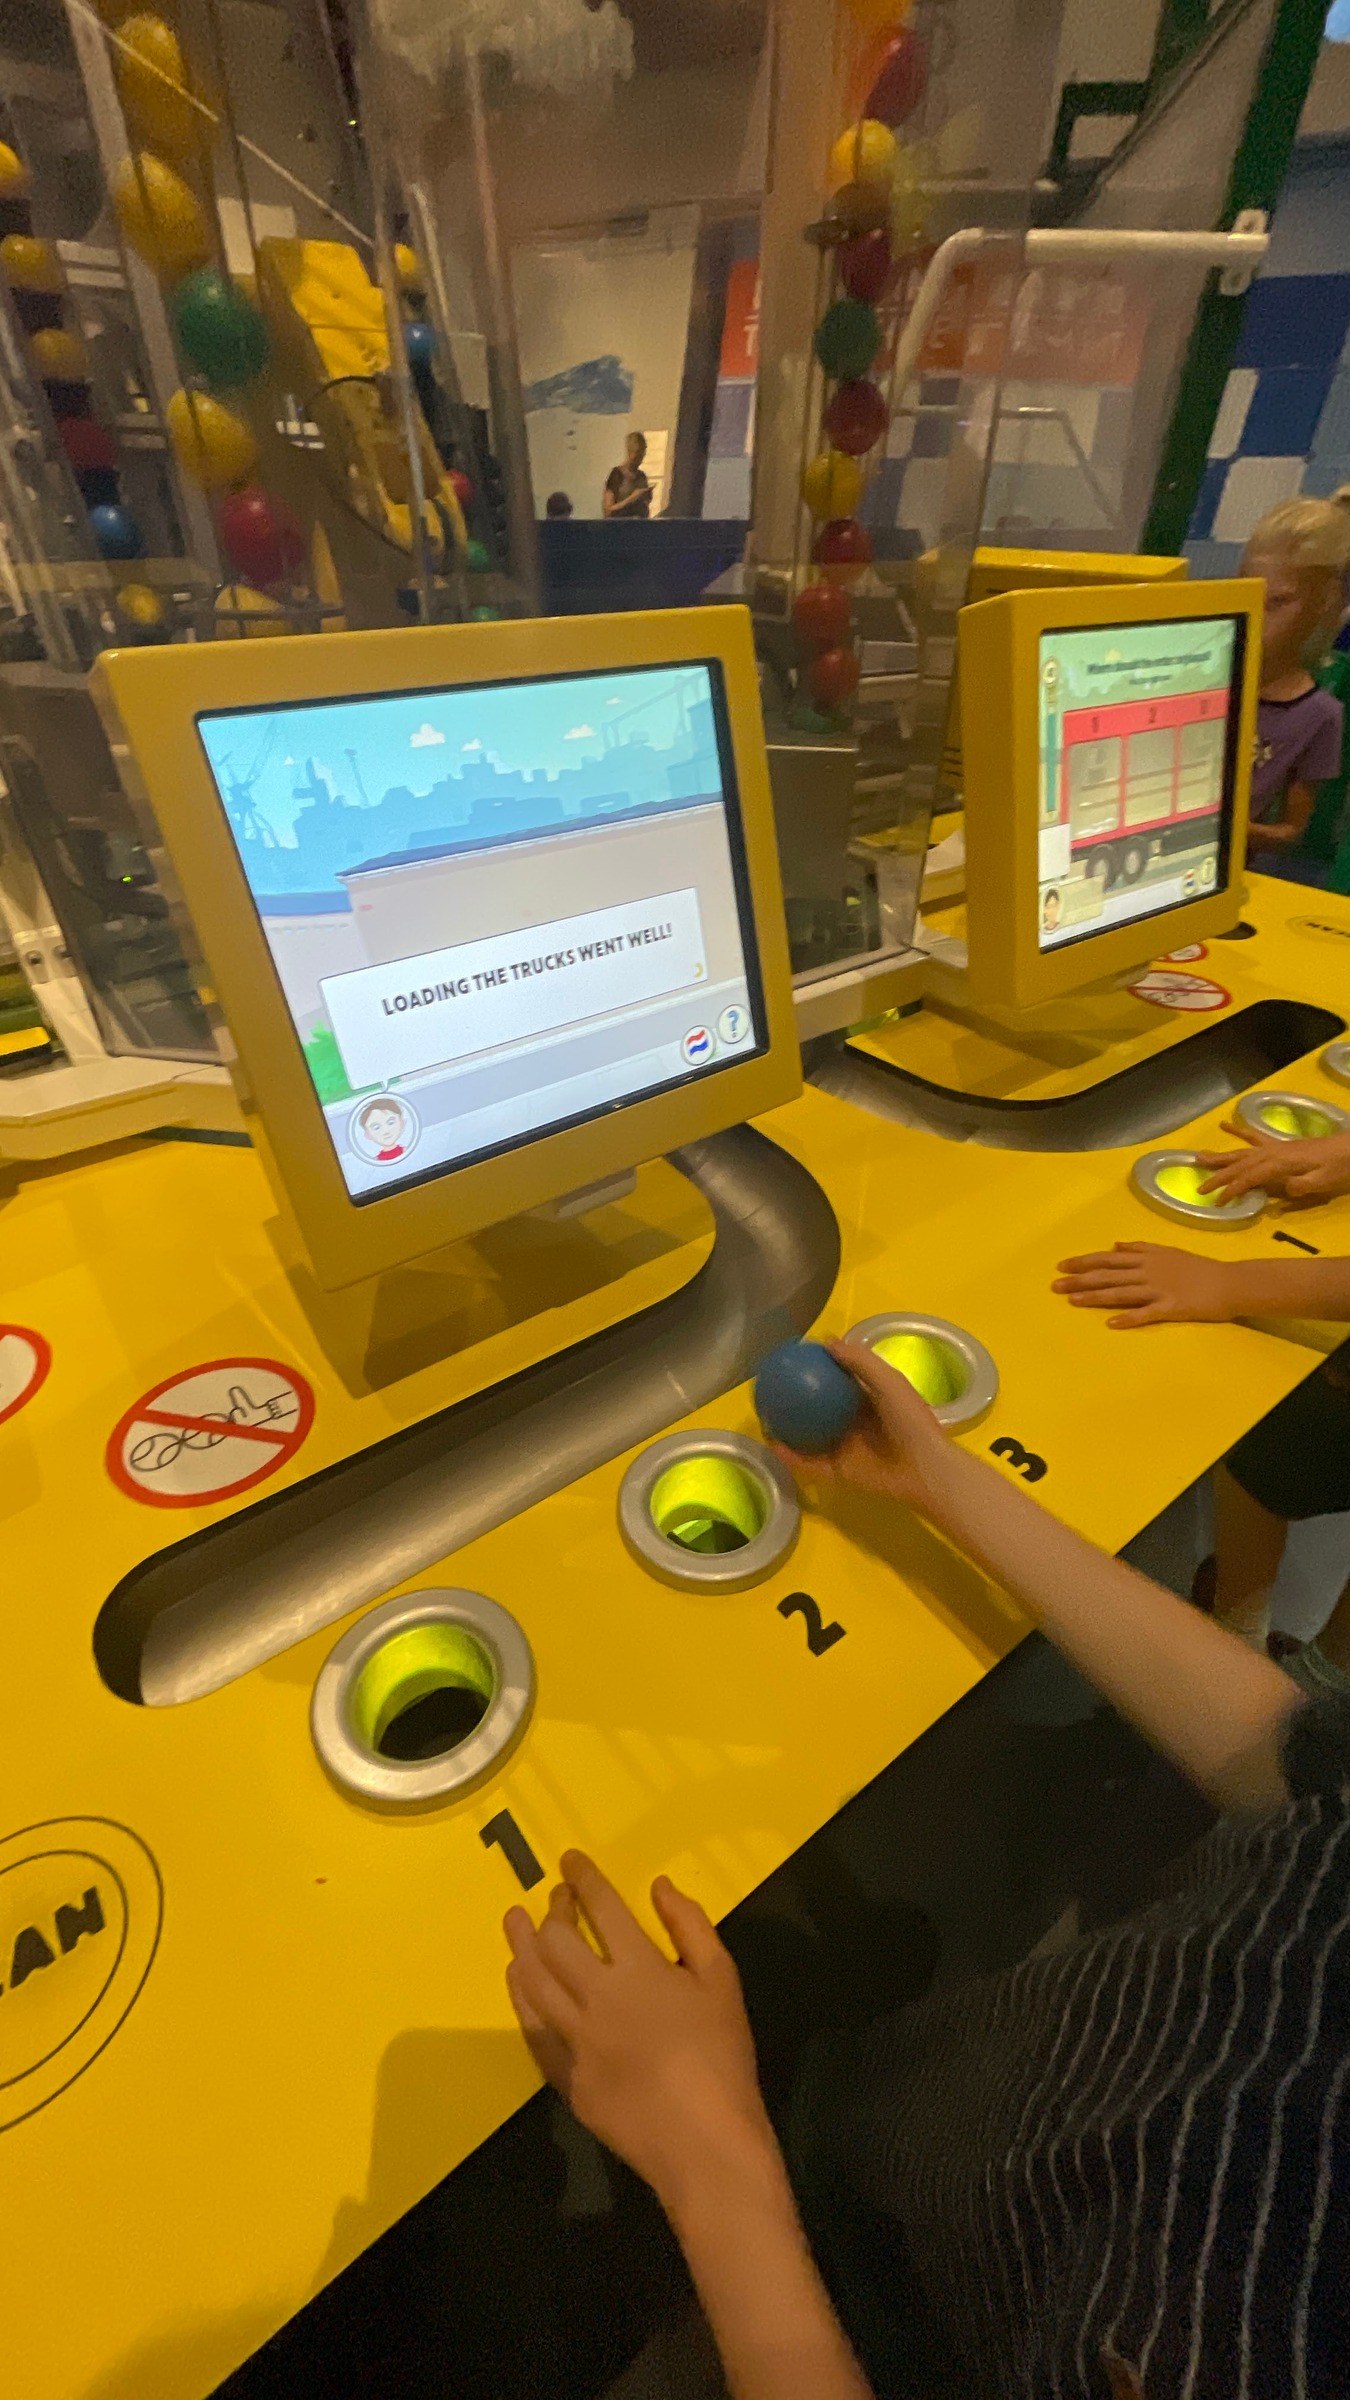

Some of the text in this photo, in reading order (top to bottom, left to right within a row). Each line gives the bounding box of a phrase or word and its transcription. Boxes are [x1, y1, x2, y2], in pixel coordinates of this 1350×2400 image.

[382, 922, 672, 1016] LOADING THE TRUCKS WENT WELL!
[728, 1009, 739, 1038] ?
[1272, 1231, 1321, 1255] 1
[989, 1436, 1048, 1483] 3
[777, 1592, 847, 1657] 2
[479, 1808, 546, 1892] 1
[0, 1886, 106, 1997] AN
